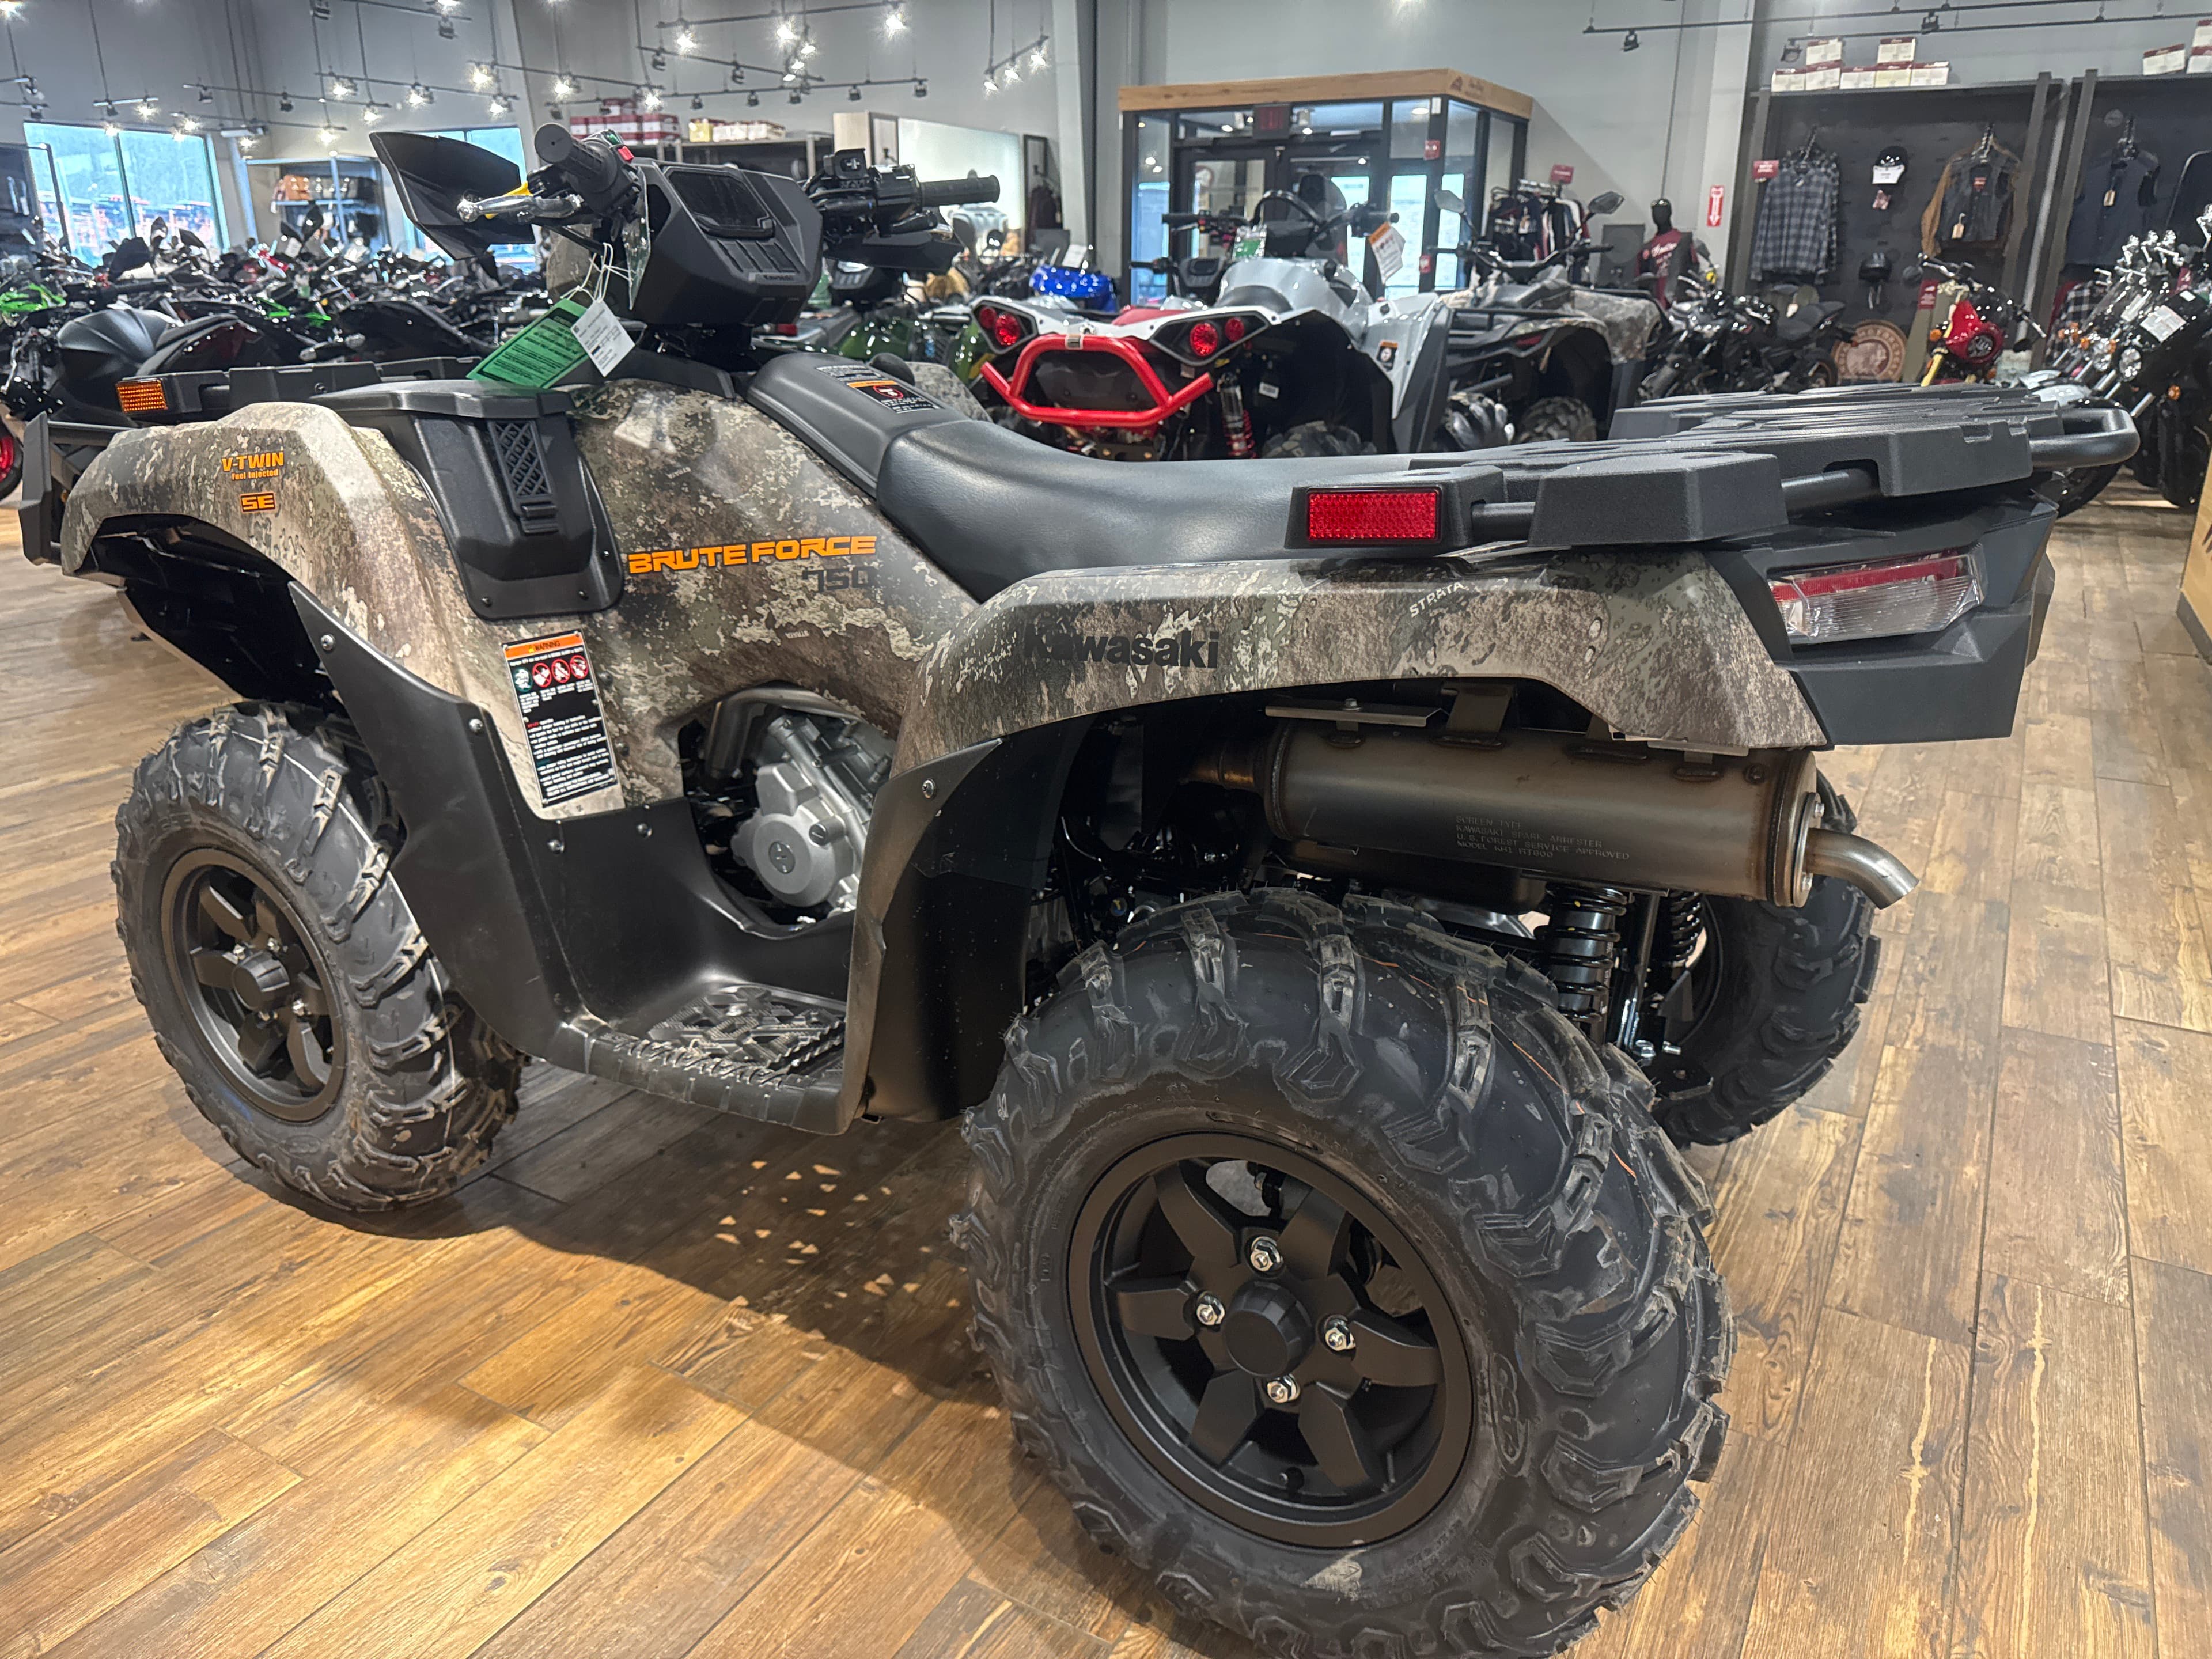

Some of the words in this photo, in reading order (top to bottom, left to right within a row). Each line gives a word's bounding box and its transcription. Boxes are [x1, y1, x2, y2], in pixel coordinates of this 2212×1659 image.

[221, 452, 285, 472] V-TWIN
[232, 471, 246, 480] Fuel
[248, 468, 279, 479] Injected
[241, 495, 275, 511] SE
[628, 544, 747, 574] BRUTE
[752, 536, 877, 563] FORCE
[802, 567, 876, 593] 750
[1410, 582, 1465, 618] STRATA
[535, 641, 560, 651] WARNING
[1024, 623, 1219, 669] Kawasaki
[1456, 815, 1493, 825] SCREEN
[1456, 824, 1503, 836] KAWASAKI
[1512, 832, 1544, 841] SPARK
[1550, 835, 1603, 848] ARRESTER
[1457, 840, 1488, 850] MODEL
[1480, 835, 1518, 847] FOREST
[1525, 842, 1570, 853] SERVICE
[1576, 847, 1630, 860] APPROVED
